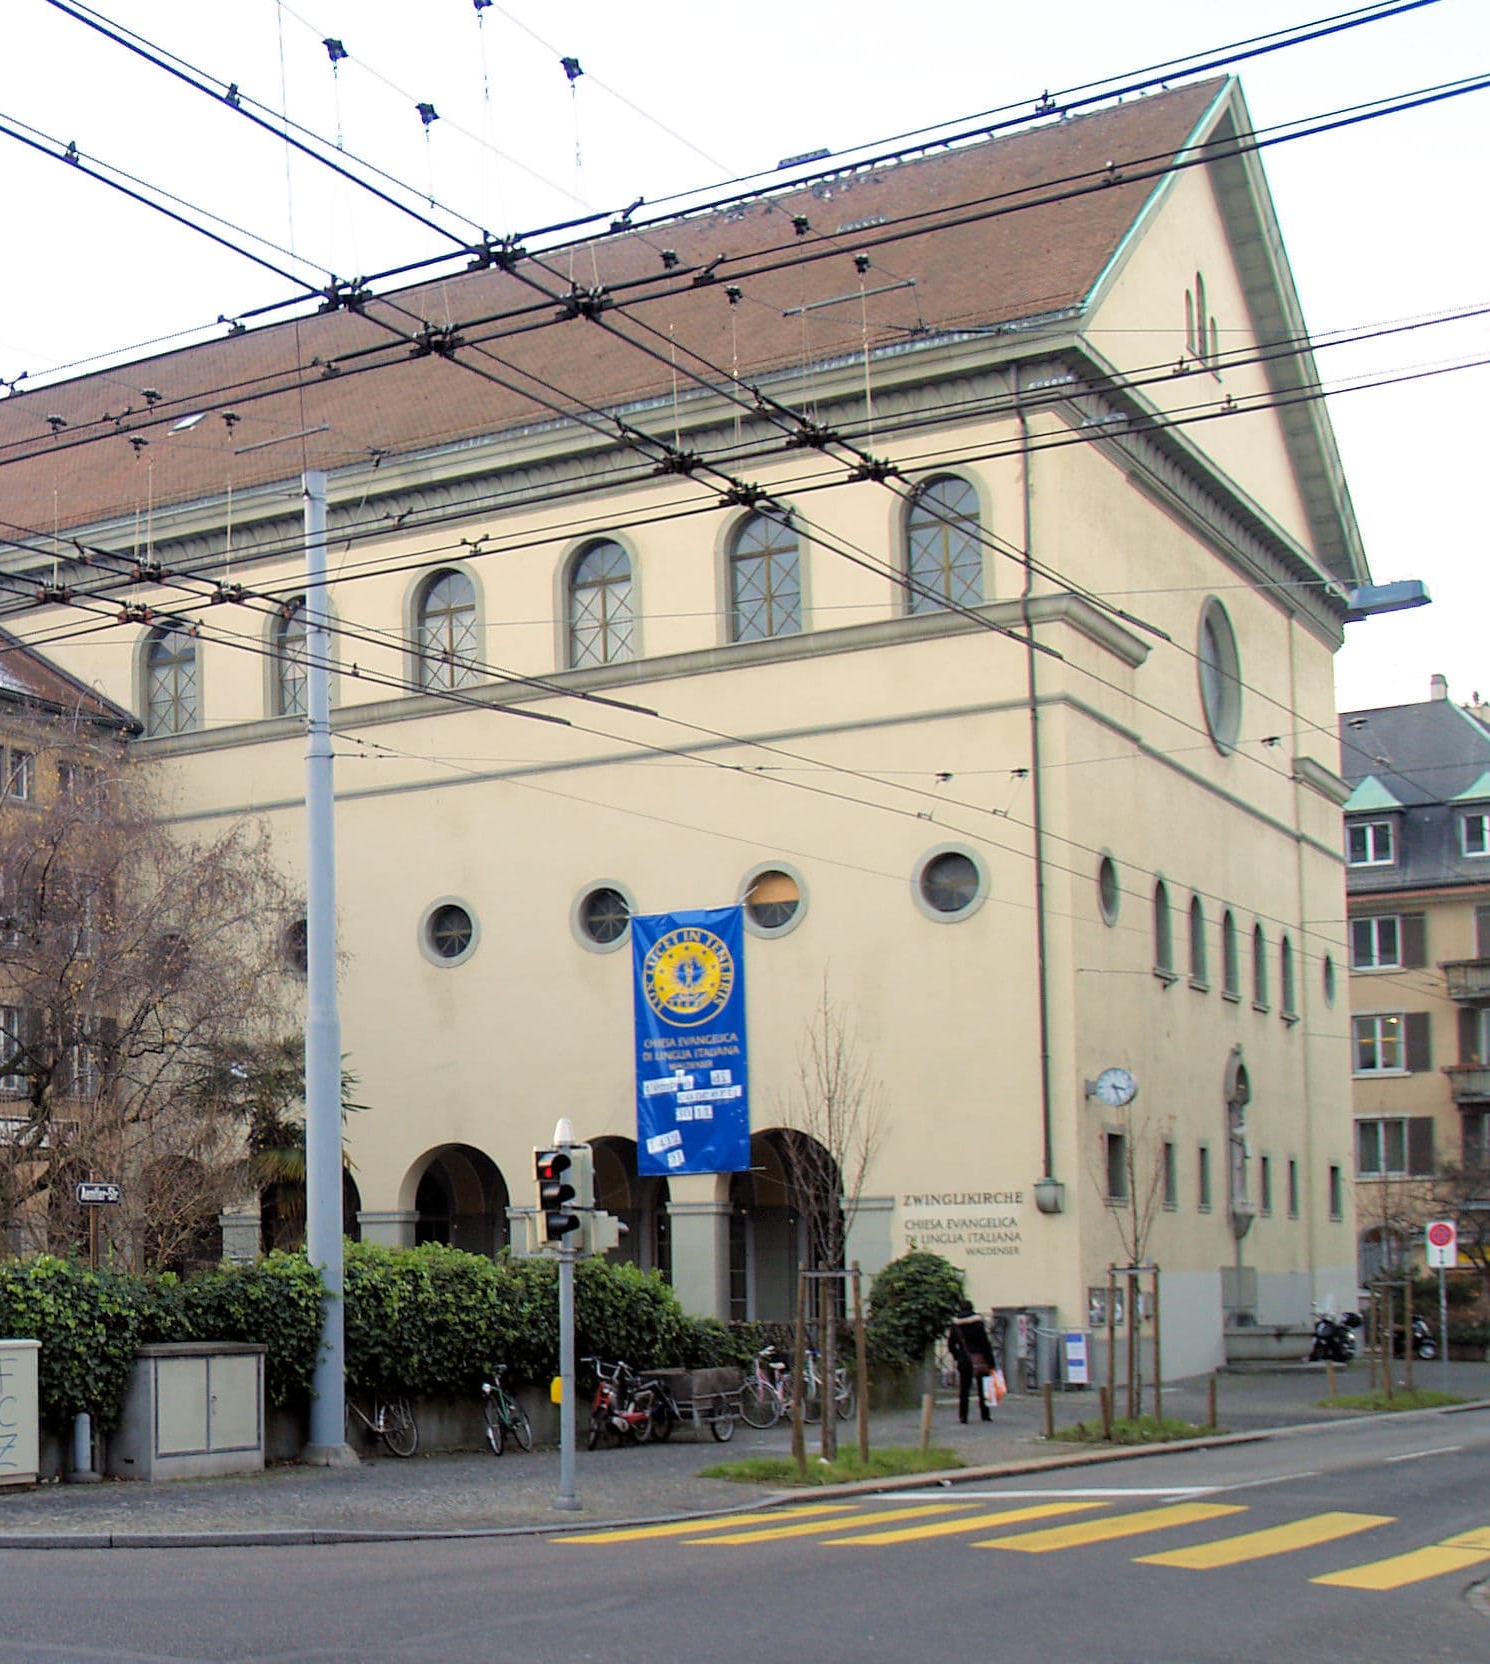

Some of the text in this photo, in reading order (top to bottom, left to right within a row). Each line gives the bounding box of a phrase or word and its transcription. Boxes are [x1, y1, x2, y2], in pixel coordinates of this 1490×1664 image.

[684, 930, 701, 942] IN
[903, 1191, 1023, 1206] ZWINGLIKIRCHE
[904, 1216, 1018, 1230] CHIESA EVANGELICA
[921, 1233, 965, 1244] LINGUA
[968, 1231, 1022, 1243] ITALIANA
[965, 1245, 1021, 1256] WALDENSER
